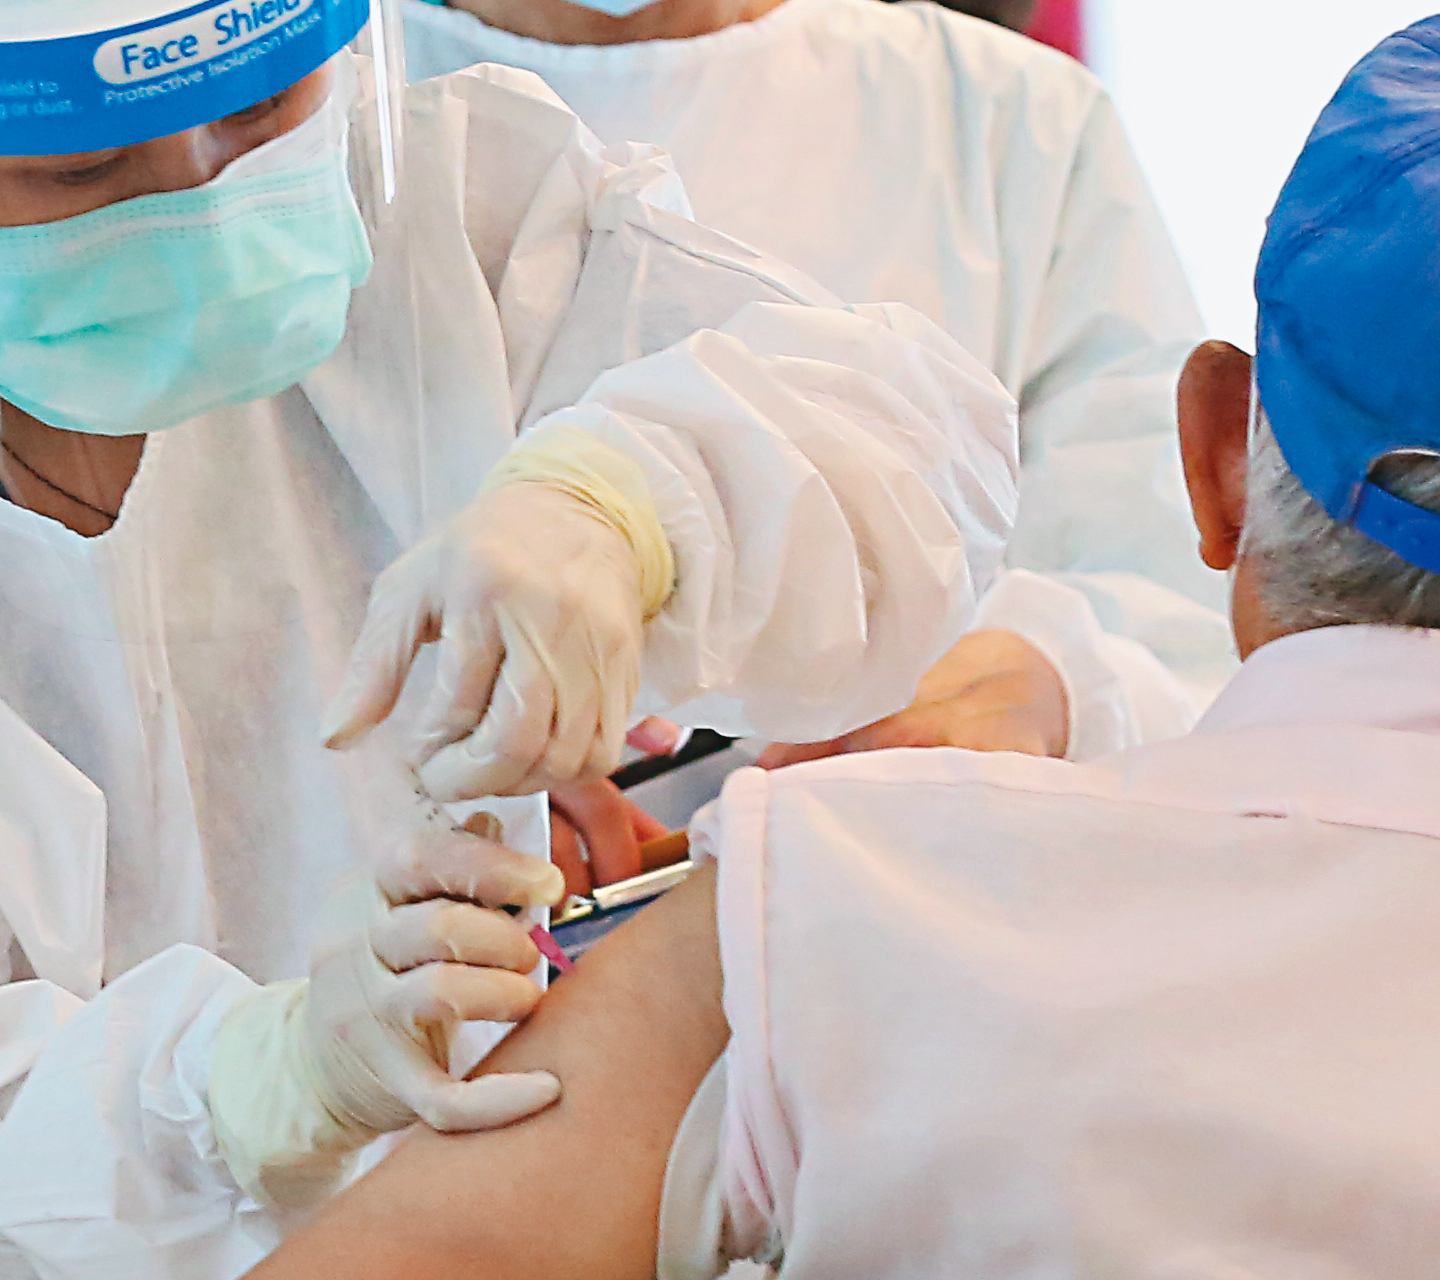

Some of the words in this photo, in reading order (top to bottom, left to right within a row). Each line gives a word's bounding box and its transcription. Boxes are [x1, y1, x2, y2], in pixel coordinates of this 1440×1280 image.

[104, 68, 204, 105] Protective
[208, 35, 281, 76] Isolation
[121, 33, 198, 74] Face
[37, 79, 60, 94] to
